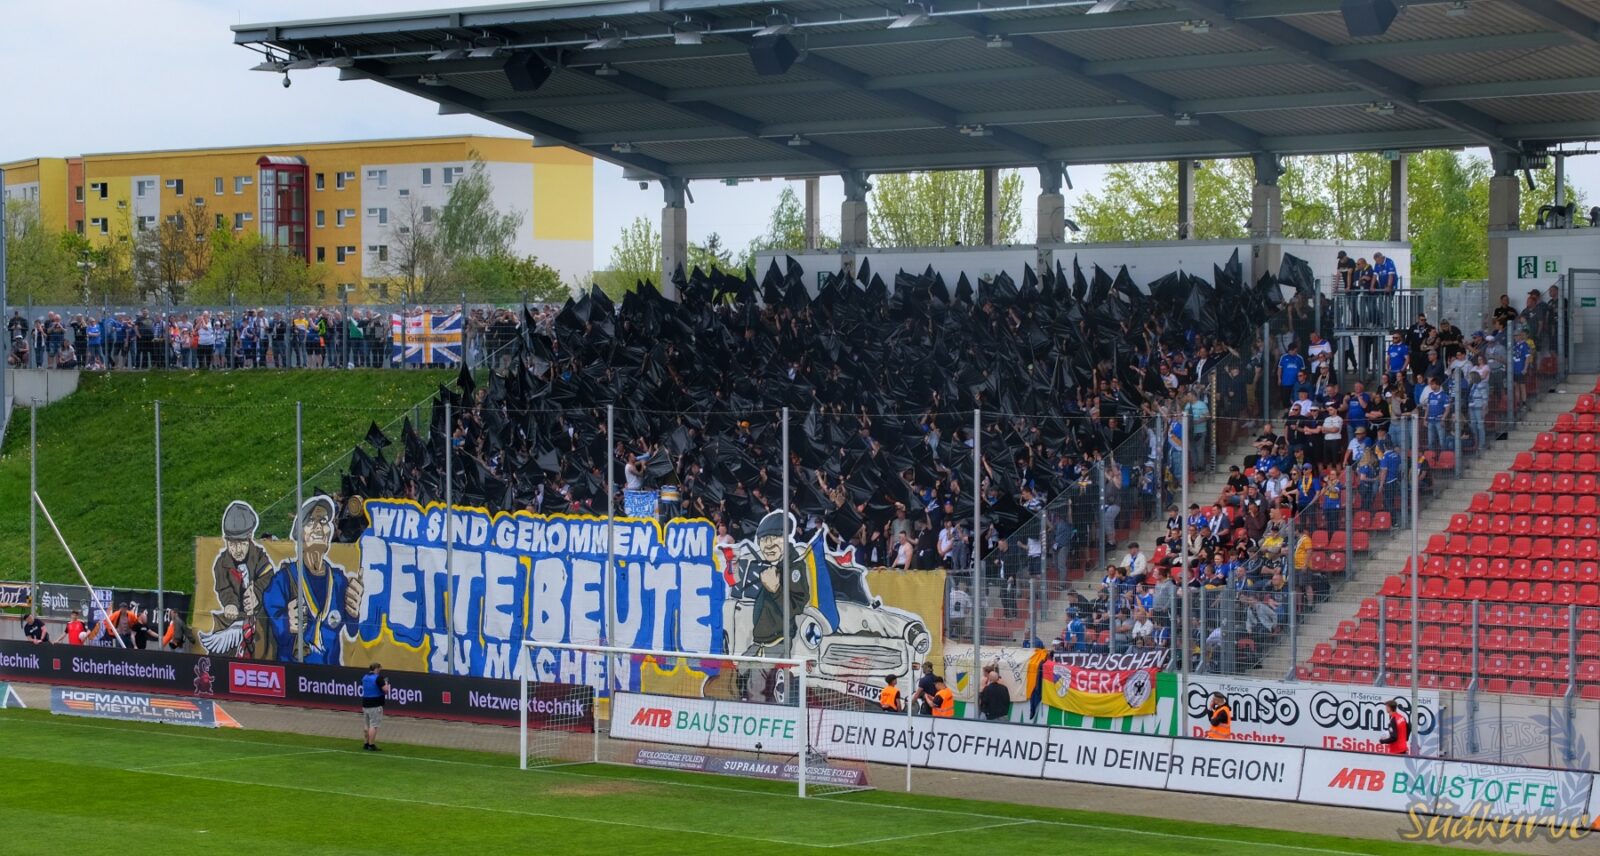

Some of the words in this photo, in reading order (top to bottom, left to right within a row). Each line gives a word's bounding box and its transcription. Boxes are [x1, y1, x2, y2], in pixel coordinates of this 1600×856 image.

[1545, 261, 1558, 272] E1
[371, 507, 418, 539] WIR
[426, 510, 488, 545] SIND
[496, 520, 658, 563] GEKOMMEN,
[668, 526, 708, 559] UM
[42, 591, 69, 610] Spidi
[359, 536, 517, 640] FETTE
[530, 557, 714, 653] BEUTE
[0, 652, 40, 669] technik
[72, 657, 175, 680] Sicherheitstechnik
[431, 633, 471, 675] ZU
[484, 642, 631, 692] MACHEN
[234, 669, 281, 689] DESA
[1076, 671, 1122, 694] GERA
[298, 676, 422, 704] Brandmellagen
[848, 683, 881, 700] Z.RK9
[1219, 684, 1248, 693] IT-Service
[62, 691, 149, 706] HOFMANN
[1350, 692, 1381, 701] IT-Service
[1418, 697, 1432, 705] mbH
[96, 703, 162, 717] METALL
[631, 707, 673, 729] MTB
[676, 712, 796, 740] BAUSTOFFE
[1193, 726, 1286, 744] Danschutz
[638, 749, 682, 761] ÖKOLOGISCHE
[682, 754, 705, 763] FOLIEN
[831, 724, 874, 748] DEIN
[882, 730, 1069, 764] BAUSTOFFHANDEL
[1077, 745, 1097, 766] IN
[1104, 747, 1185, 776] DEINER
[1192, 755, 1286, 784] REGION!
[723, 761, 779, 774] SUPRAMAX
[783, 764, 832, 776] ÖKOGISCHE
[832, 769, 858, 778] FOLIEN
[1328, 767, 1386, 792] MTB
[1392, 771, 1558, 808] BAUSTOFFE
